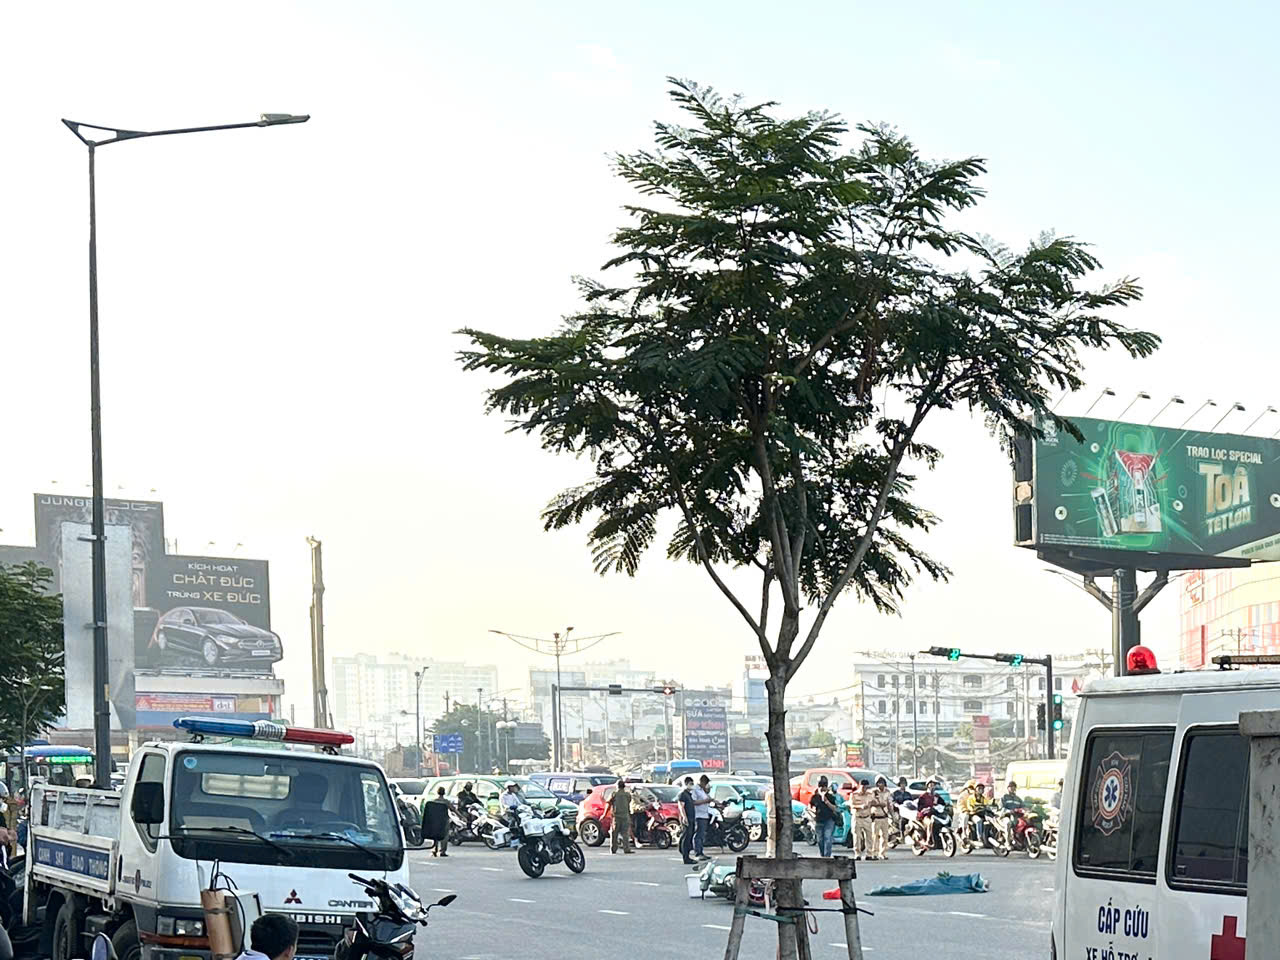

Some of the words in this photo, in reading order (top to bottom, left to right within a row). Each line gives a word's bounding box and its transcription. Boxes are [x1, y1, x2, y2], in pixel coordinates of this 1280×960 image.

[1186, 445, 1210, 458] TRAO
[1229, 450, 1263, 465] SPECIAL
[188, 562, 211, 571] KÍCH
[203, 591, 223, 602] XE
[227, 589, 261, 604] ĐỨC
[327, 899, 374, 909] CANTER
[1098, 897, 1121, 935] CẤP
[1124, 904, 1150, 939] CỨU
